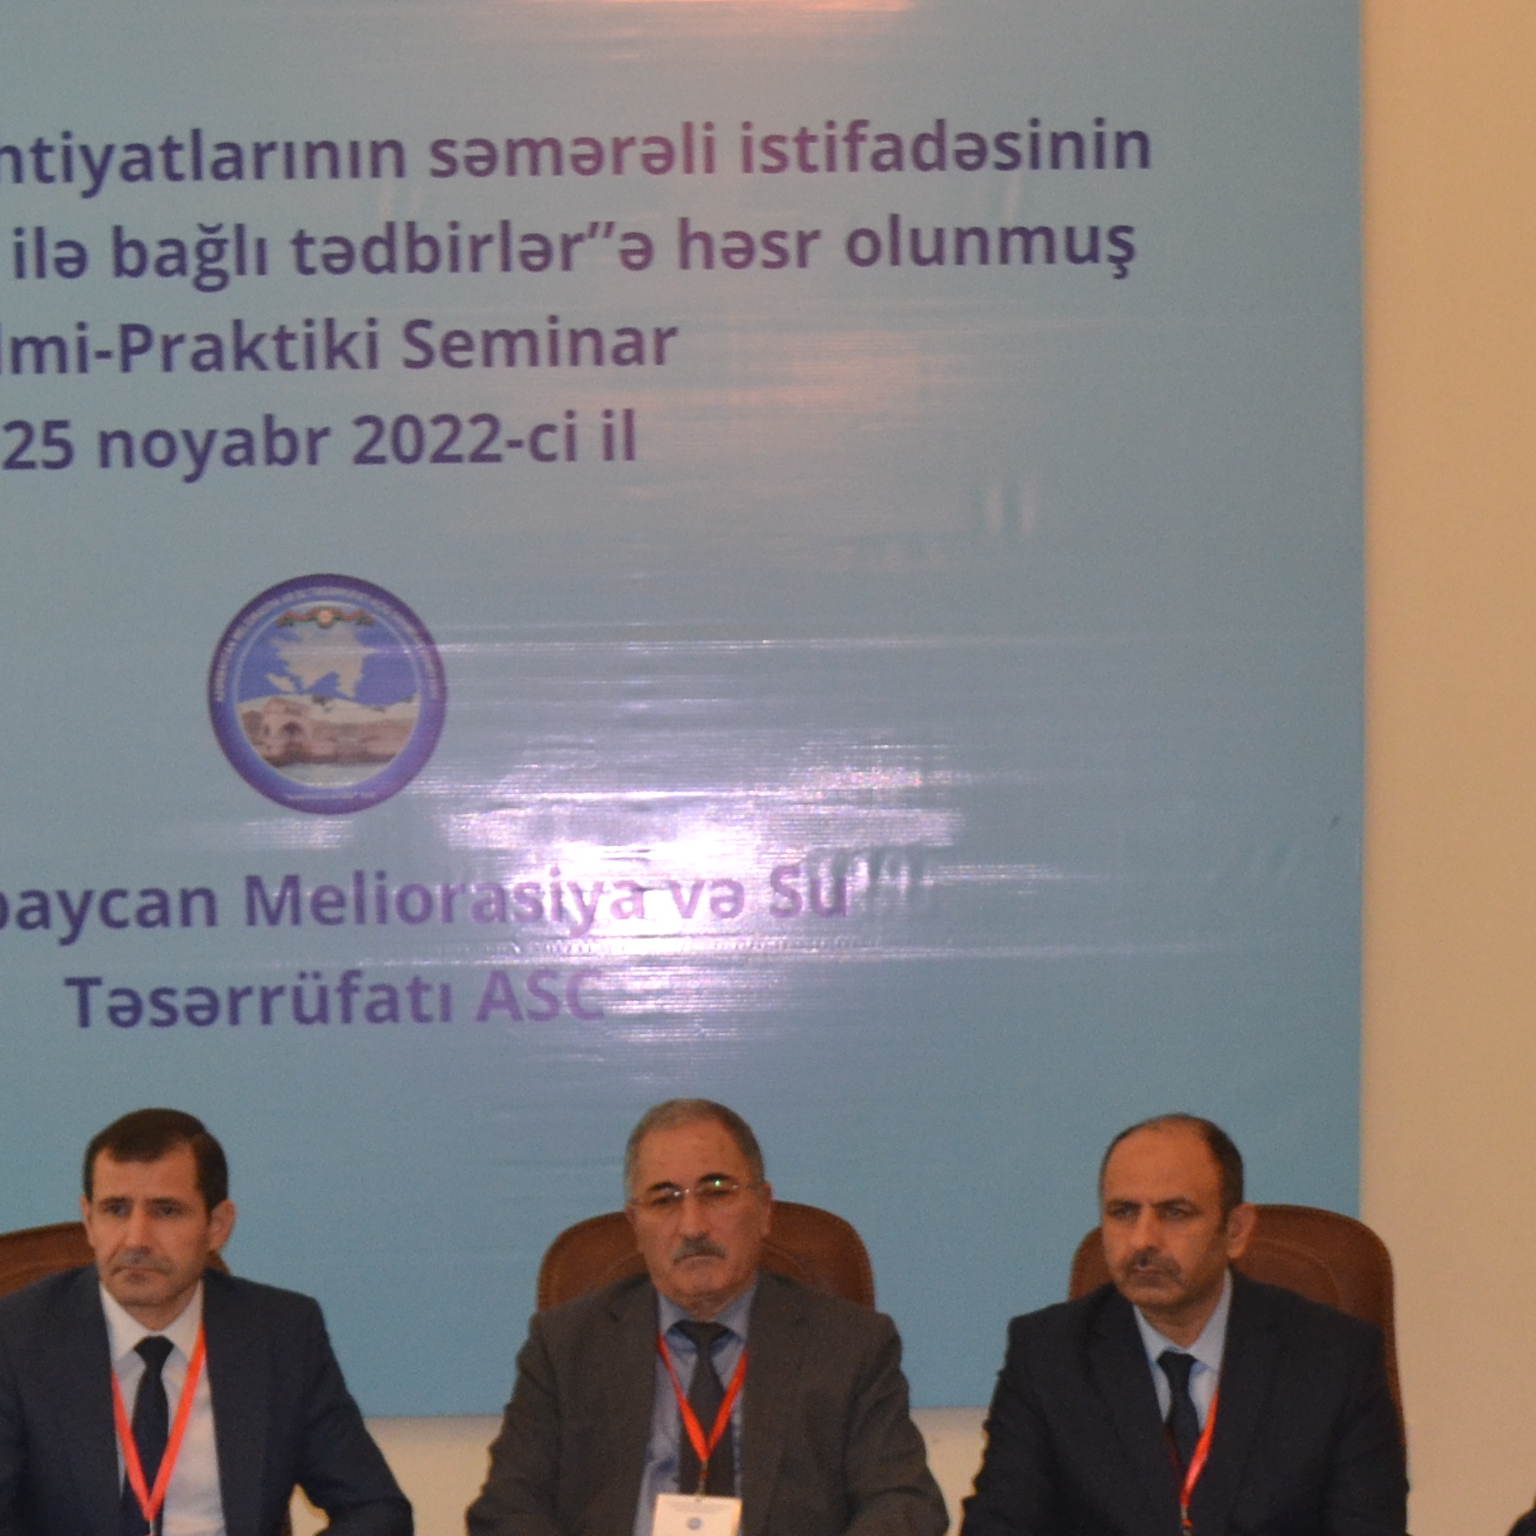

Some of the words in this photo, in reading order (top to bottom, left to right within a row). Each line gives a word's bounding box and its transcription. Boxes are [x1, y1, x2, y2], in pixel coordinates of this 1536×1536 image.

[428, 120, 716, 179] səmərəli
[740, 116, 1152, 175] istifadəsinin
[12, 225, 90, 281] ilə
[111, 222, 269, 294] bağlı
[677, 216, 822, 271] həsr
[844, 212, 1137, 281] olunmuş
[402, 313, 680, 371] Seminar
[1, 418, 76, 471] 25
[97, 412, 332, 485] noyabr
[351, 408, 578, 466] 2022-ci
[601, 407, 636, 462] il
[244, 865, 647, 938] Meliorasiya
[670, 876, 748, 920] və
[769, 863, 850, 919] Su
[63, 968, 452, 1030] Təsərrüfatı
[476, 968, 606, 1022] ASC
